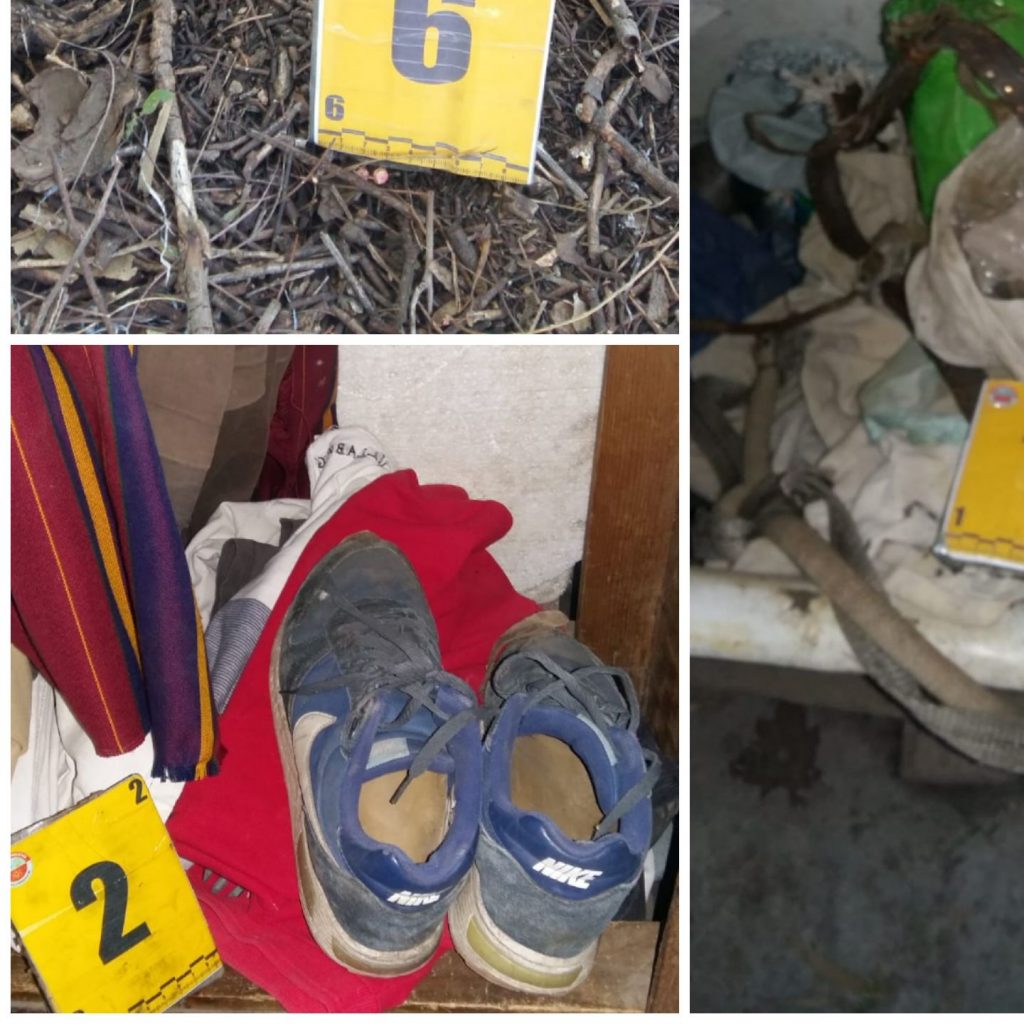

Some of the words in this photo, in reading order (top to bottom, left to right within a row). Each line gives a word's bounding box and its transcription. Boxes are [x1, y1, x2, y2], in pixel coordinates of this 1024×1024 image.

[324, 94, 345, 121] 6
[955, 506, 965, 526] 1
[129, 779, 147, 804] 2
[532, 857, 604, 890] NIKE
[70, 861, 151, 965] 2
